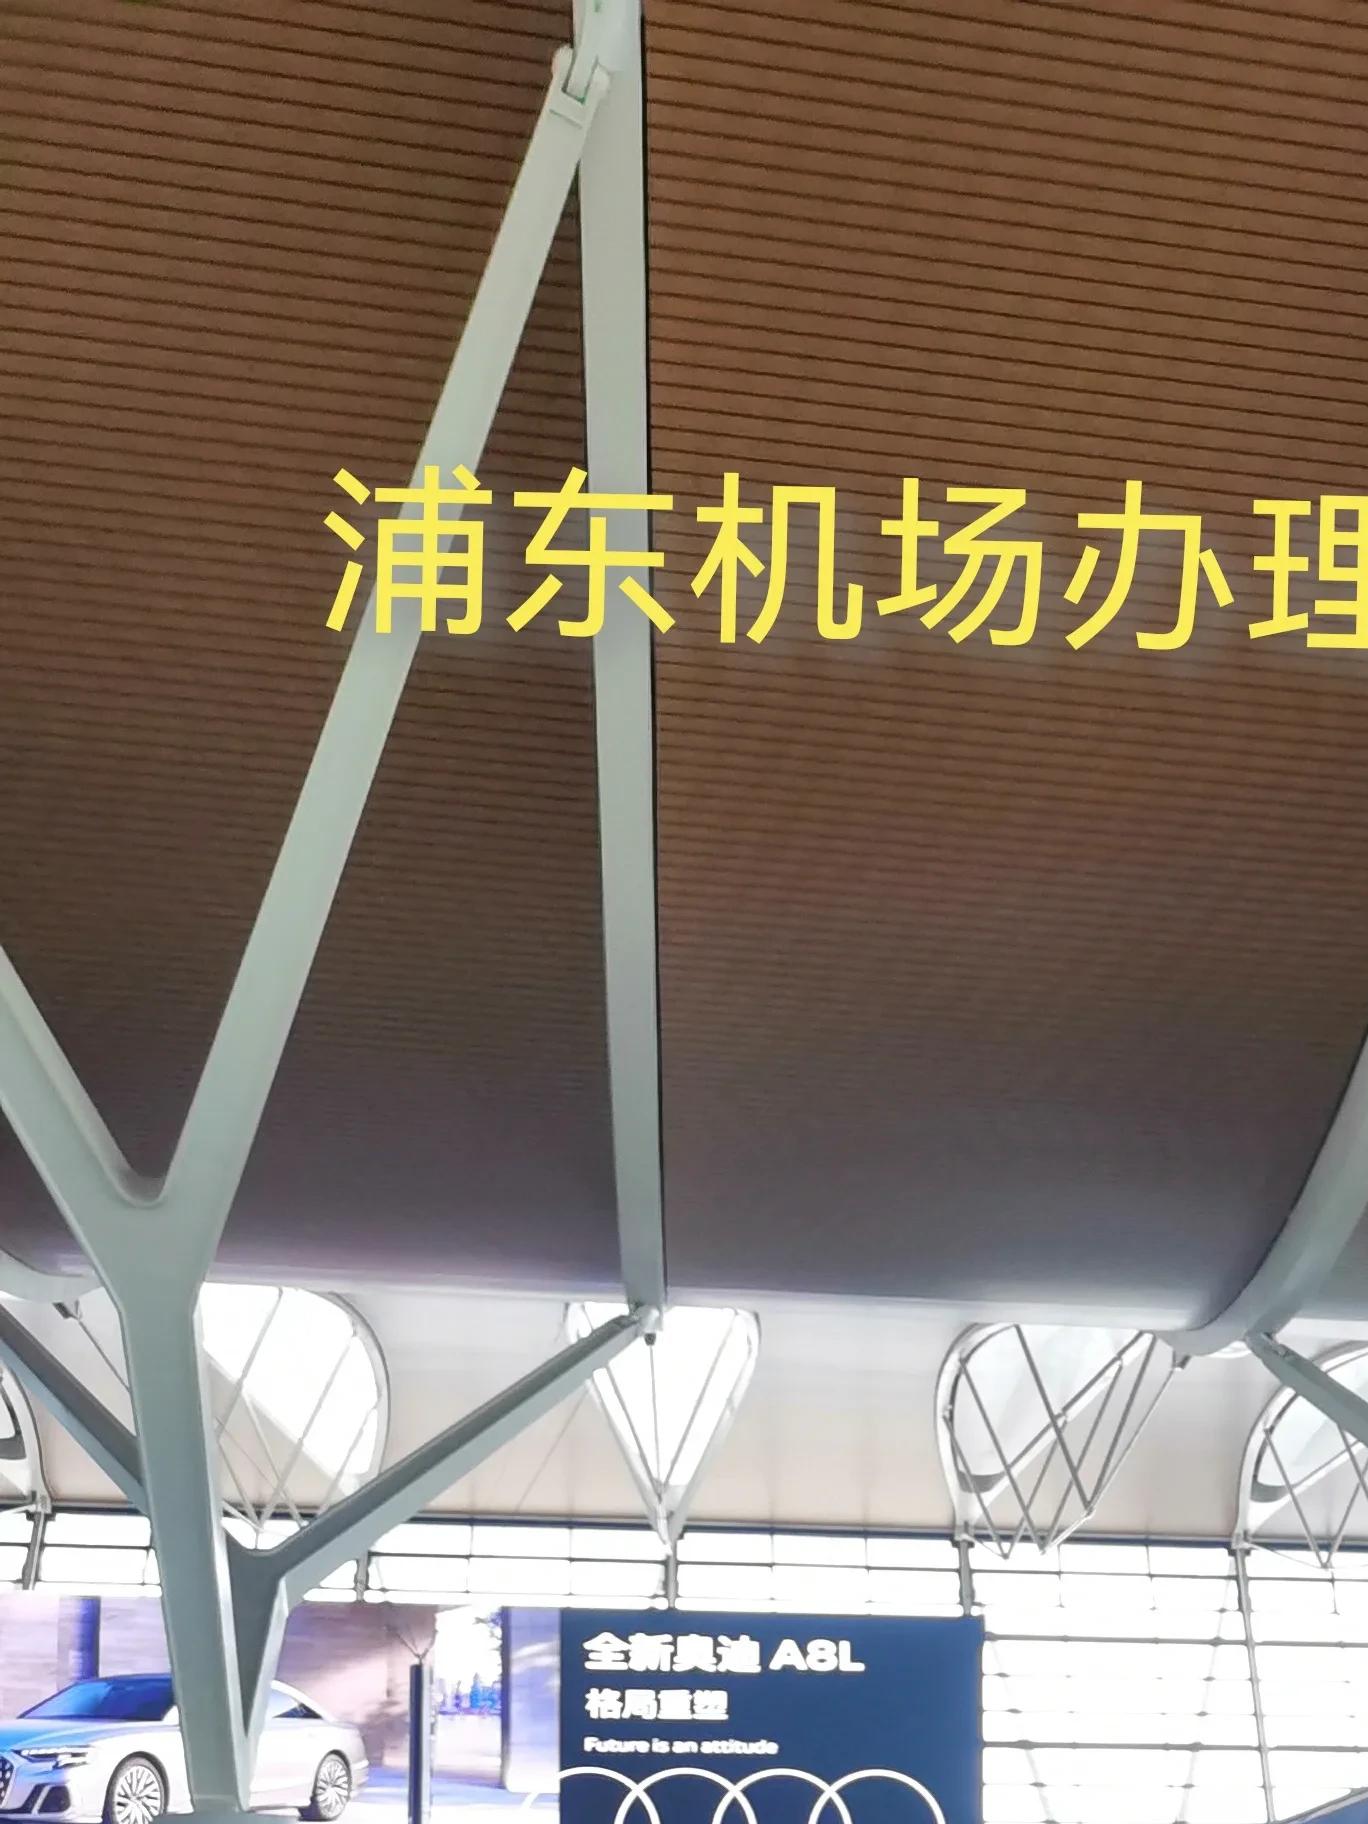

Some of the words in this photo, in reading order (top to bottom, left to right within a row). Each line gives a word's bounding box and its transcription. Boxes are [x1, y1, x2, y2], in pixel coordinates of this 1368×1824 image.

[582, 1631, 762, 1673] 全新奥迪
[769, 1638, 866, 1672] A8L
[584, 1687, 729, 1720] 格局重塑
[583, 1736, 650, 1753] Future
[651, 1737, 670, 1753] is
[672, 1740, 698, 1753] an
[700, 1739, 779, 1755] attitude
